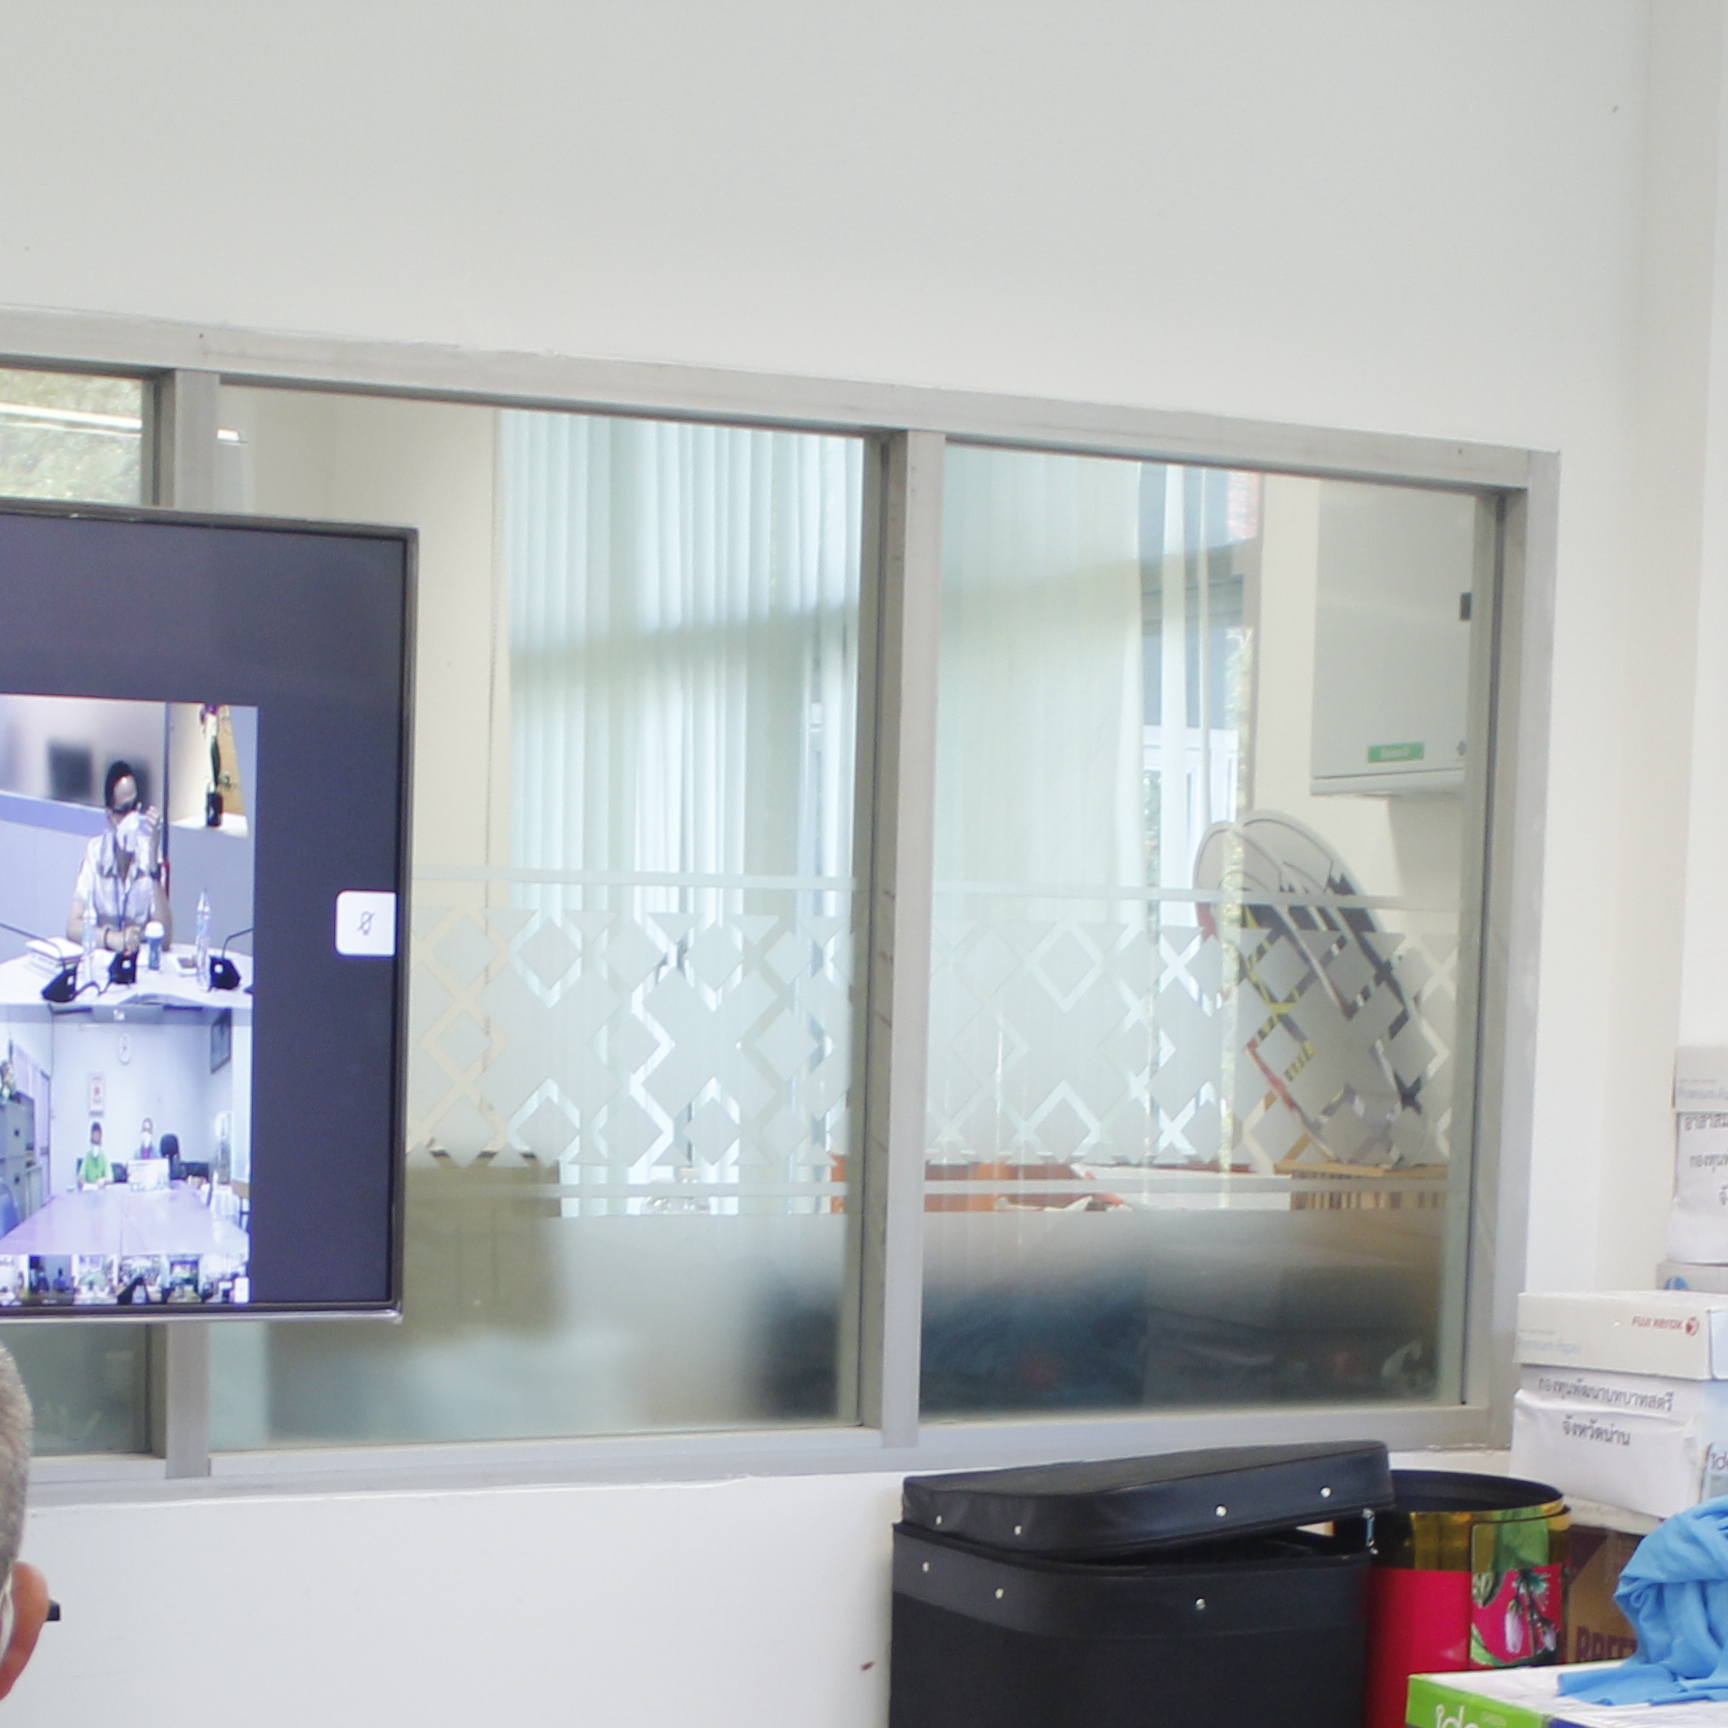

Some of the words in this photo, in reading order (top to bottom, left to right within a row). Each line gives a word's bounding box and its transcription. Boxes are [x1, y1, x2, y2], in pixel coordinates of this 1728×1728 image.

[1562, 1414, 1631, 1446] จังหวัดน่าน
